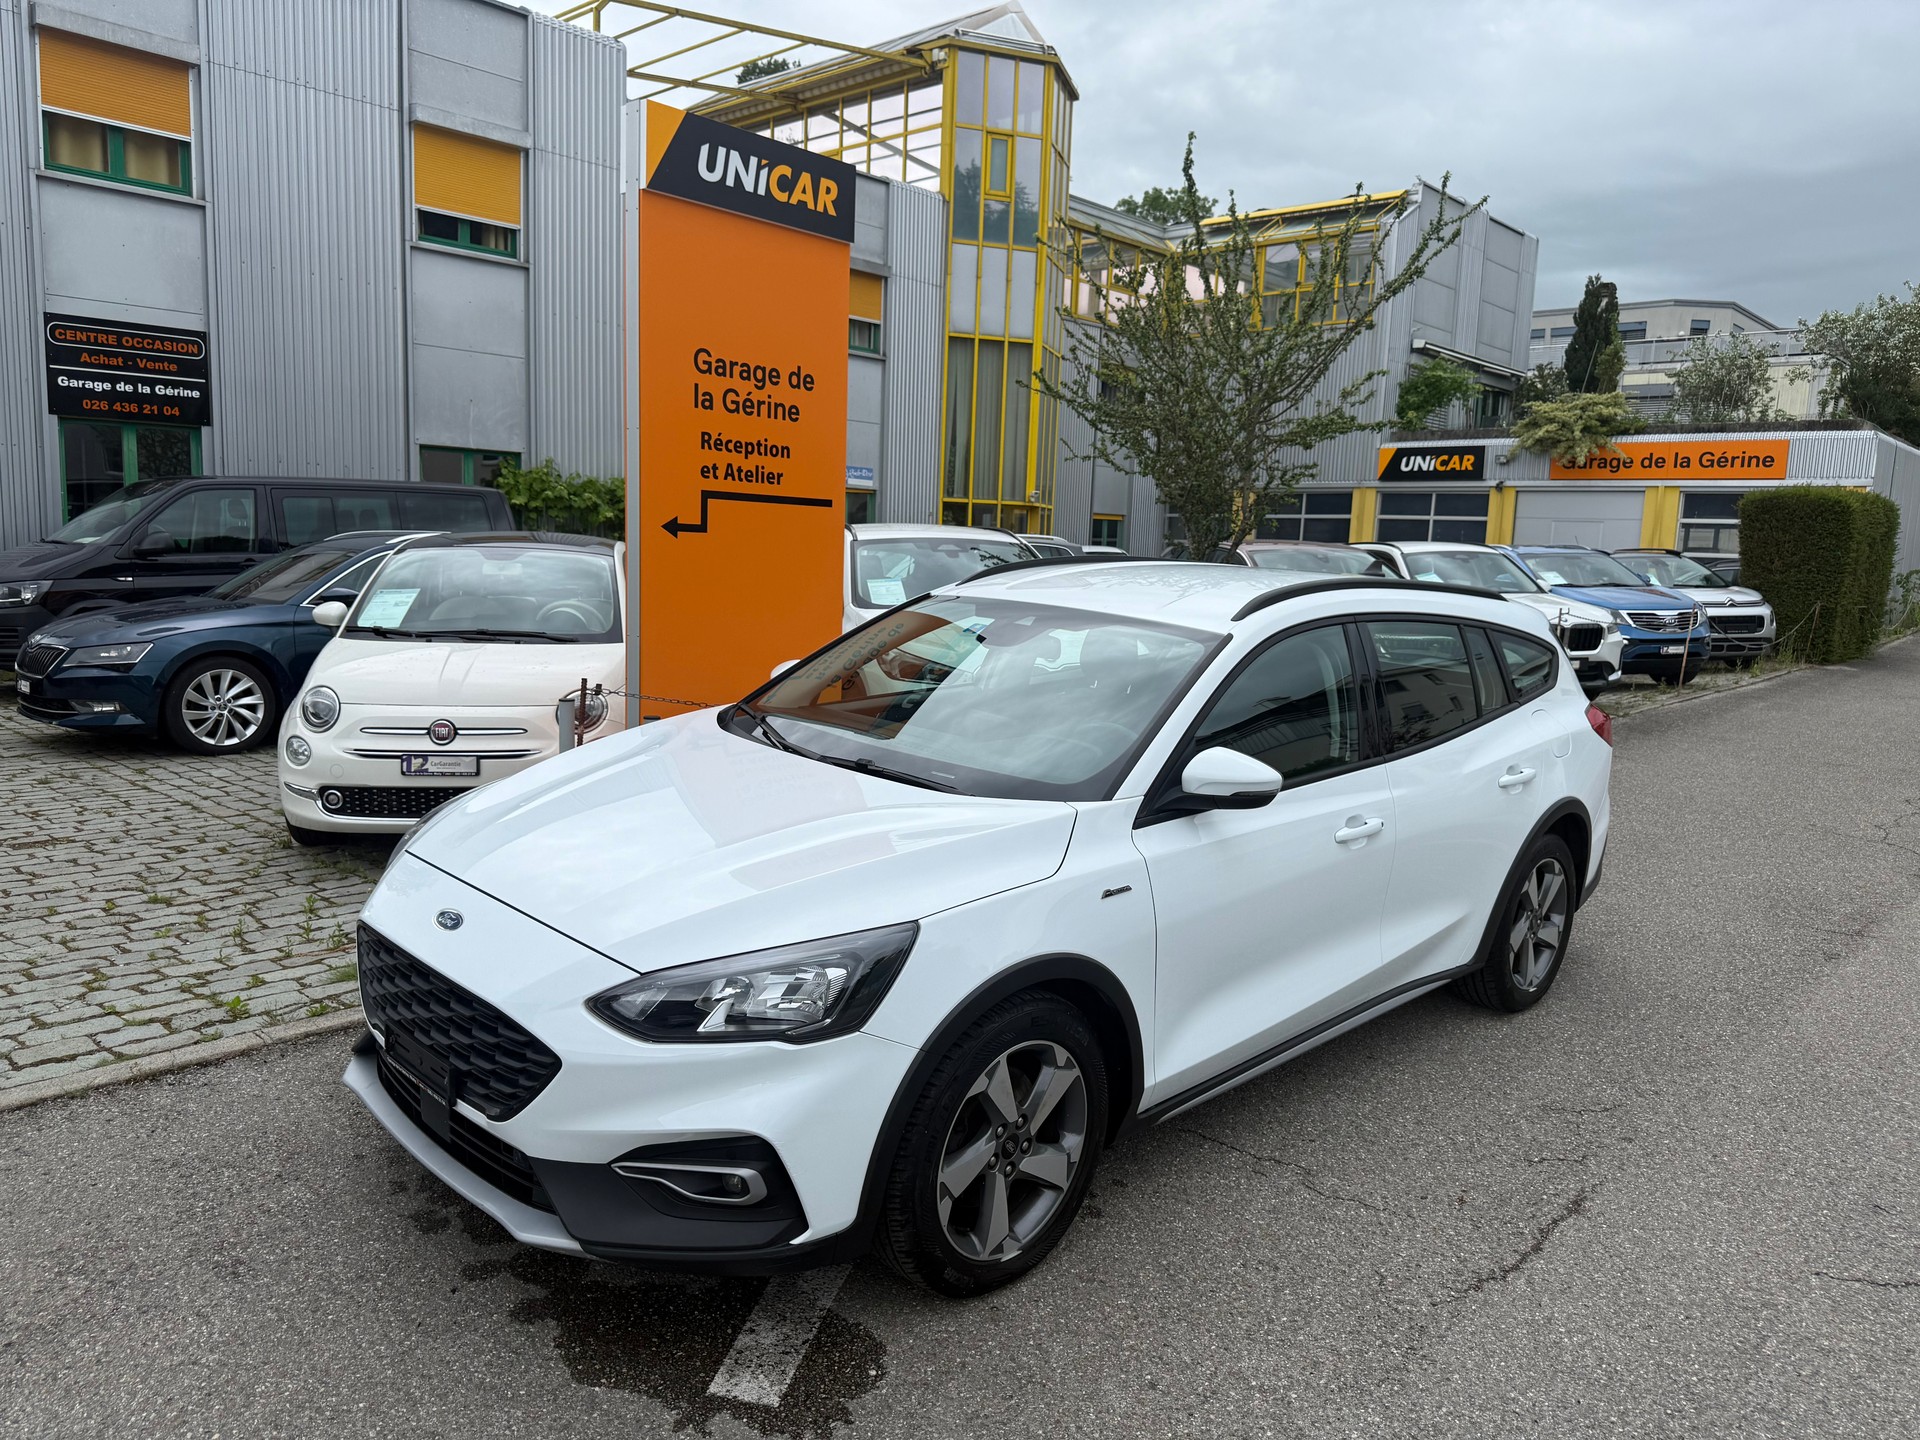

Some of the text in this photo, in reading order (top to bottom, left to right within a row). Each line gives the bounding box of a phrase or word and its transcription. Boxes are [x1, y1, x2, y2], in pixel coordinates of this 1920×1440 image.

[54, 328, 199, 354] CENTRE OCCASION
[80, 352, 124, 367] Achat
[136, 358, 178, 372] Vente
[693, 348, 815, 391] Garage de
[57, 376, 201, 398] Garage de la Gérine
[82, 399, 180, 417] 026 436 21 04
[694, 383, 800, 422] la Gérine
[700, 431, 791, 460] Réception
[1640, 452, 1666, 469] de
[1673, 452, 1691, 469] la
[1698, 451, 1775, 469] Gérine
[700, 463, 784, 485] et Atelier
[435, 727, 449, 738] FIAT
